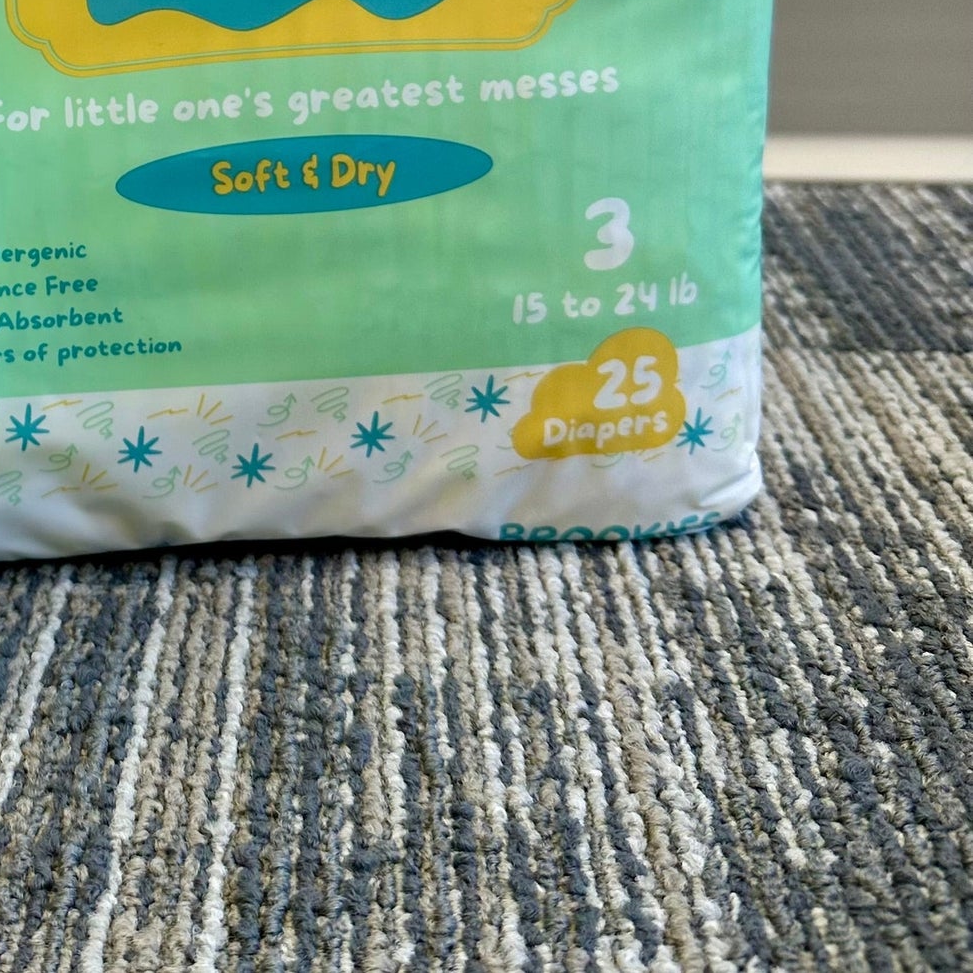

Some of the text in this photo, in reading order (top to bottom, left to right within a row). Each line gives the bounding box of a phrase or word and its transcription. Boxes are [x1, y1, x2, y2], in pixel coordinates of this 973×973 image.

[64, 92, 159, 128] little
[173, 87, 273, 122] one's
[288, 74, 465, 126] greatest
[480, 66, 619, 102] messes
[211, 153, 396, 197] Soft & Dry
[583, 196, 634, 271] 3
[45, 275, 99, 297] Free
[512, 272, 699, 325] 15 to 24 lb
[23, 342, 49, 363] of
[58, 337, 182, 366] protection
[592, 355, 663, 410] 25
[542, 410, 668, 449] Diapers
